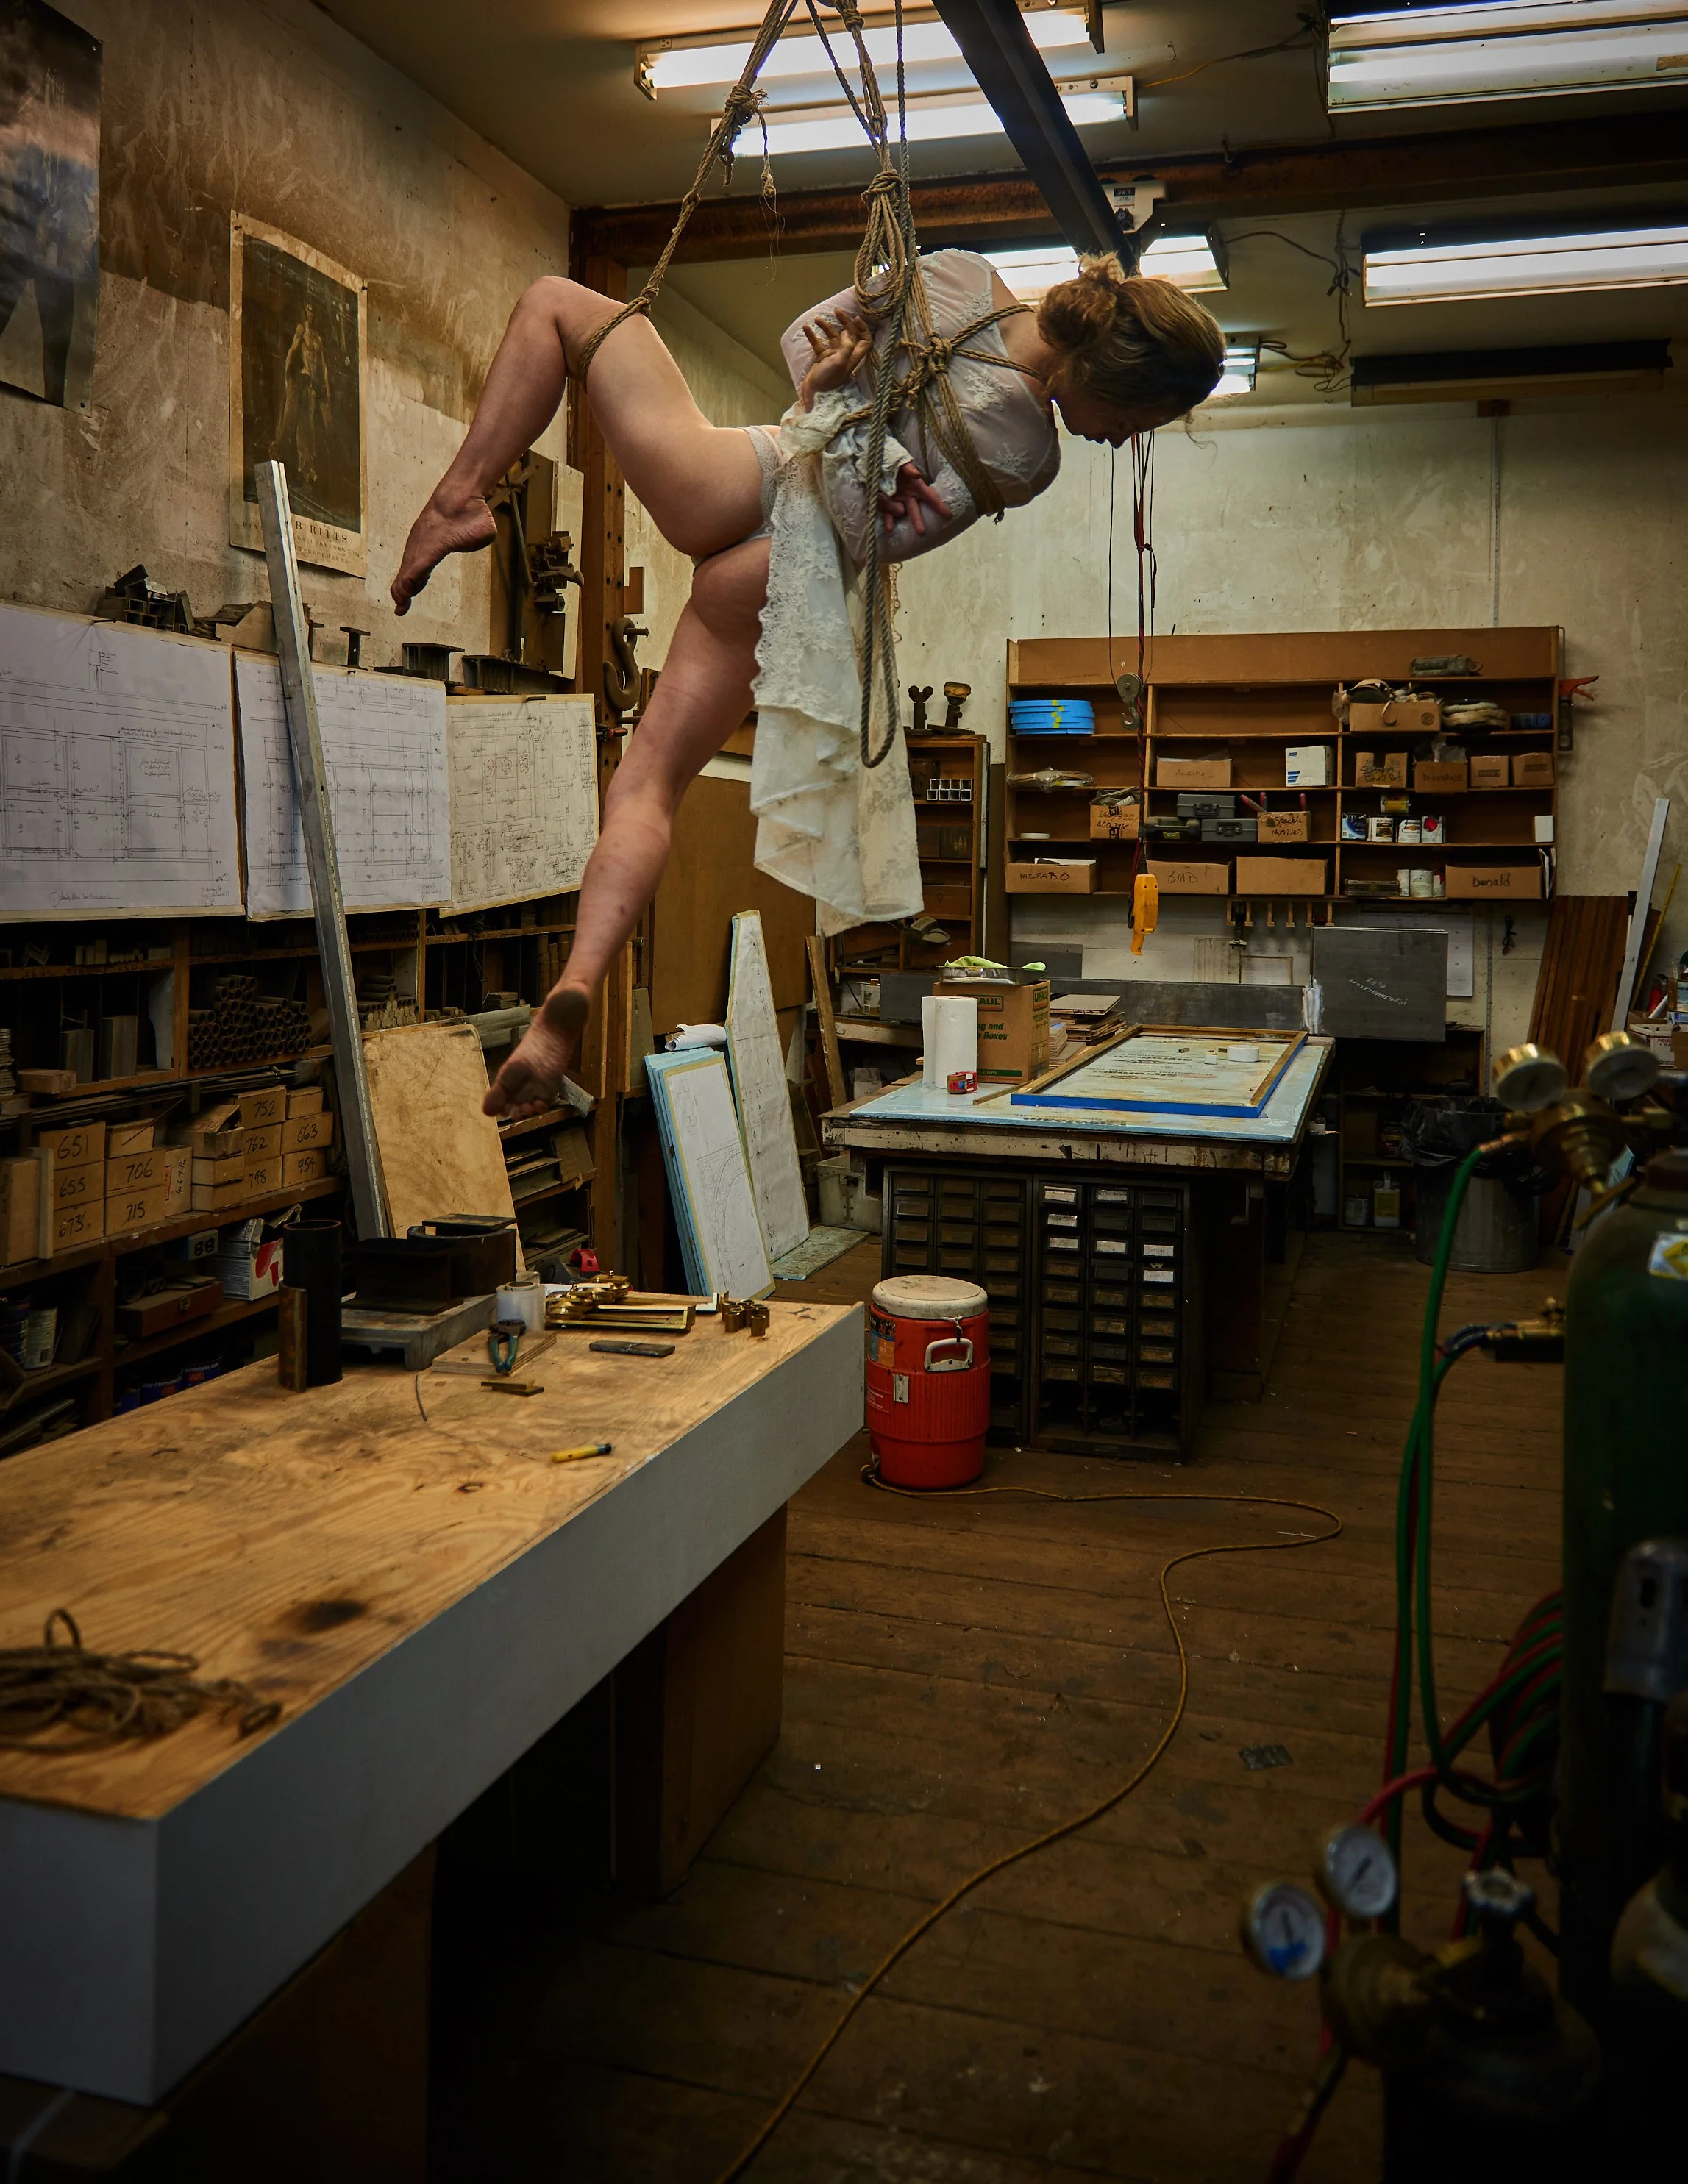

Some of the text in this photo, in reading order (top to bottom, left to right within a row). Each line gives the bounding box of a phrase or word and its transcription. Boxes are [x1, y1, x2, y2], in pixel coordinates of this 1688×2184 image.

[310, 525, 347, 542] RITTS
[1020, 872, 1069, 881] METABO
[1168, 871, 1198, 884] BMB
[979, 997, 1000, 1005] AUL
[988, 1023, 1004, 1031] and
[254, 1100, 275, 1118] 752
[297, 1123, 318, 1143] 863
[57, 1135, 88, 1160] 651
[246, 1137, 268, 1155] 762
[126, 1157, 153, 1183] 706
[297, 1154, 316, 1174] 954
[59, 1177, 86, 1198] 655
[126, 1201, 146, 1223] 715
[58, 1214, 85, 1238] 673
